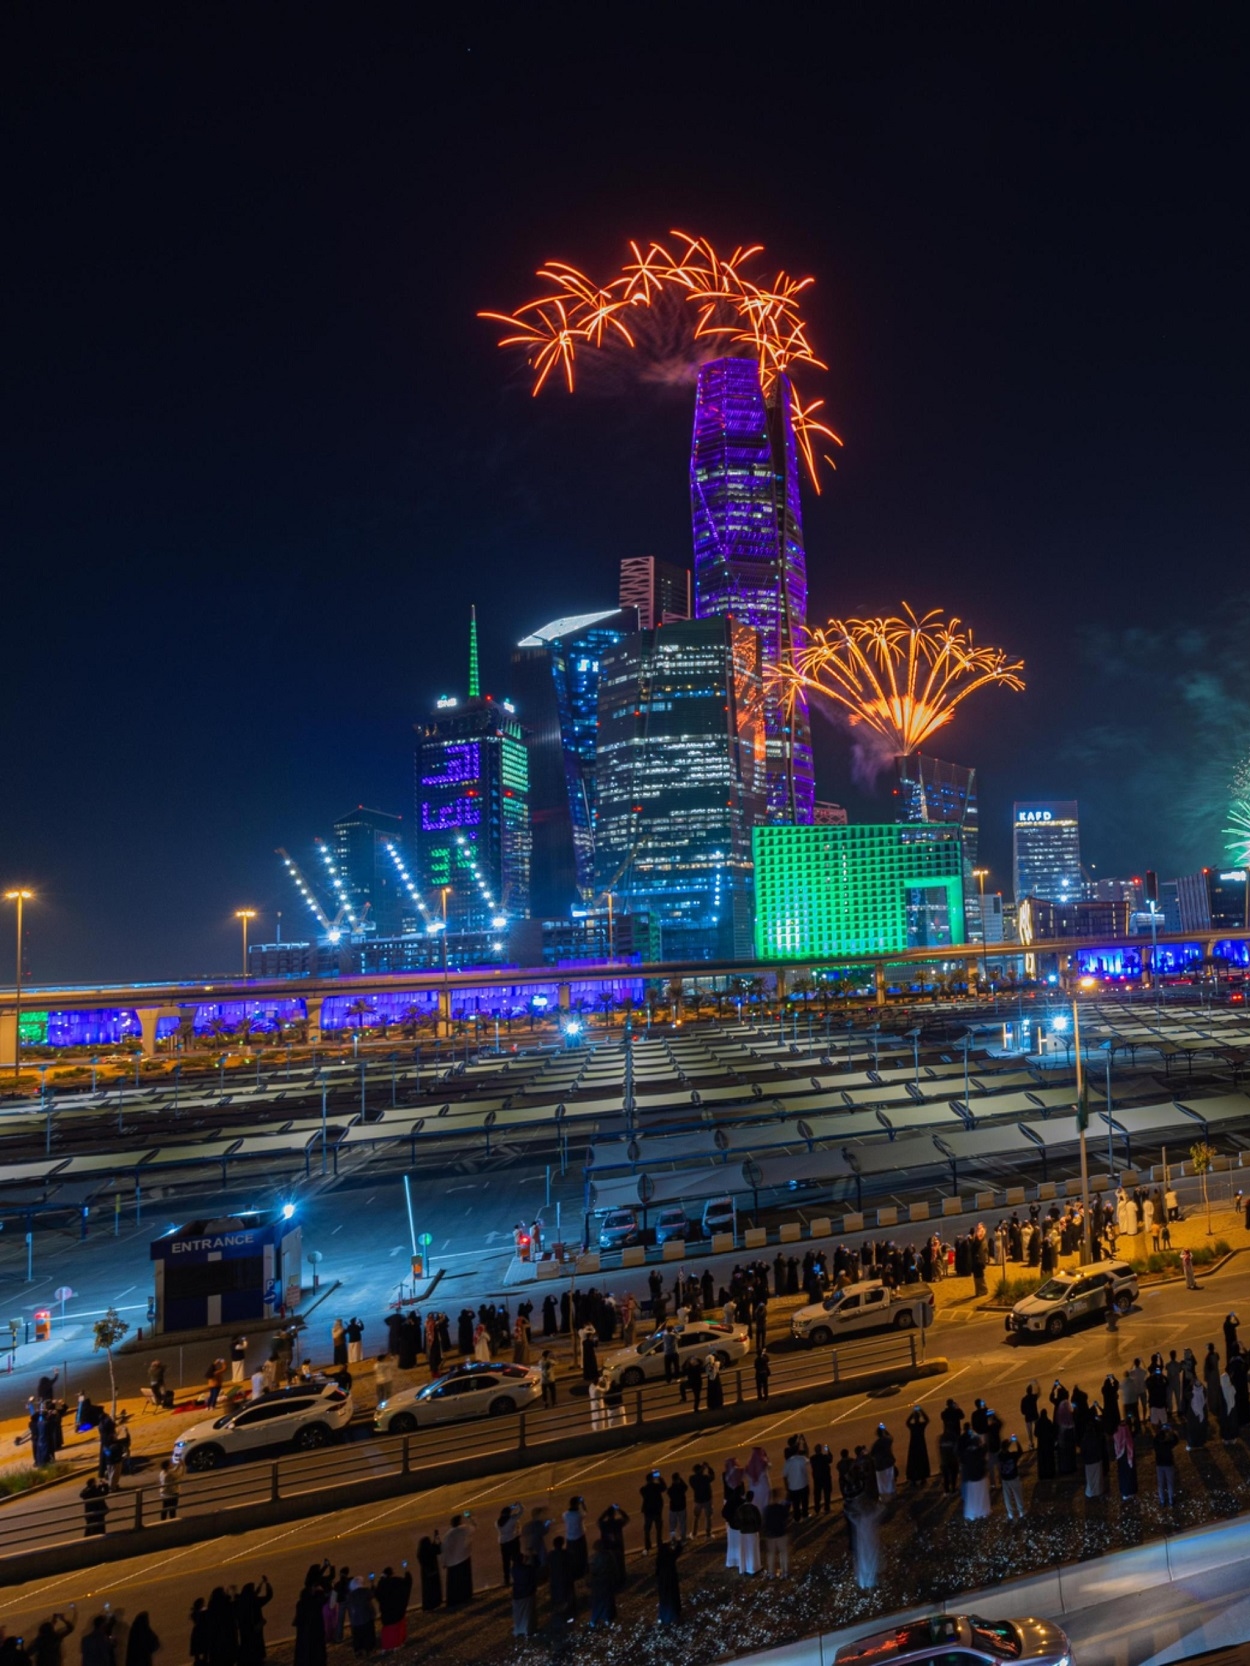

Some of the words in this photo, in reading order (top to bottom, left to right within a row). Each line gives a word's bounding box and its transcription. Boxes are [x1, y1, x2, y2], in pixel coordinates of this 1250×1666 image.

[1019, 811, 1052, 821] KAFD
[171, 1233, 255, 1254] ENTRANCE
[266, 1280, 274, 1290] P
